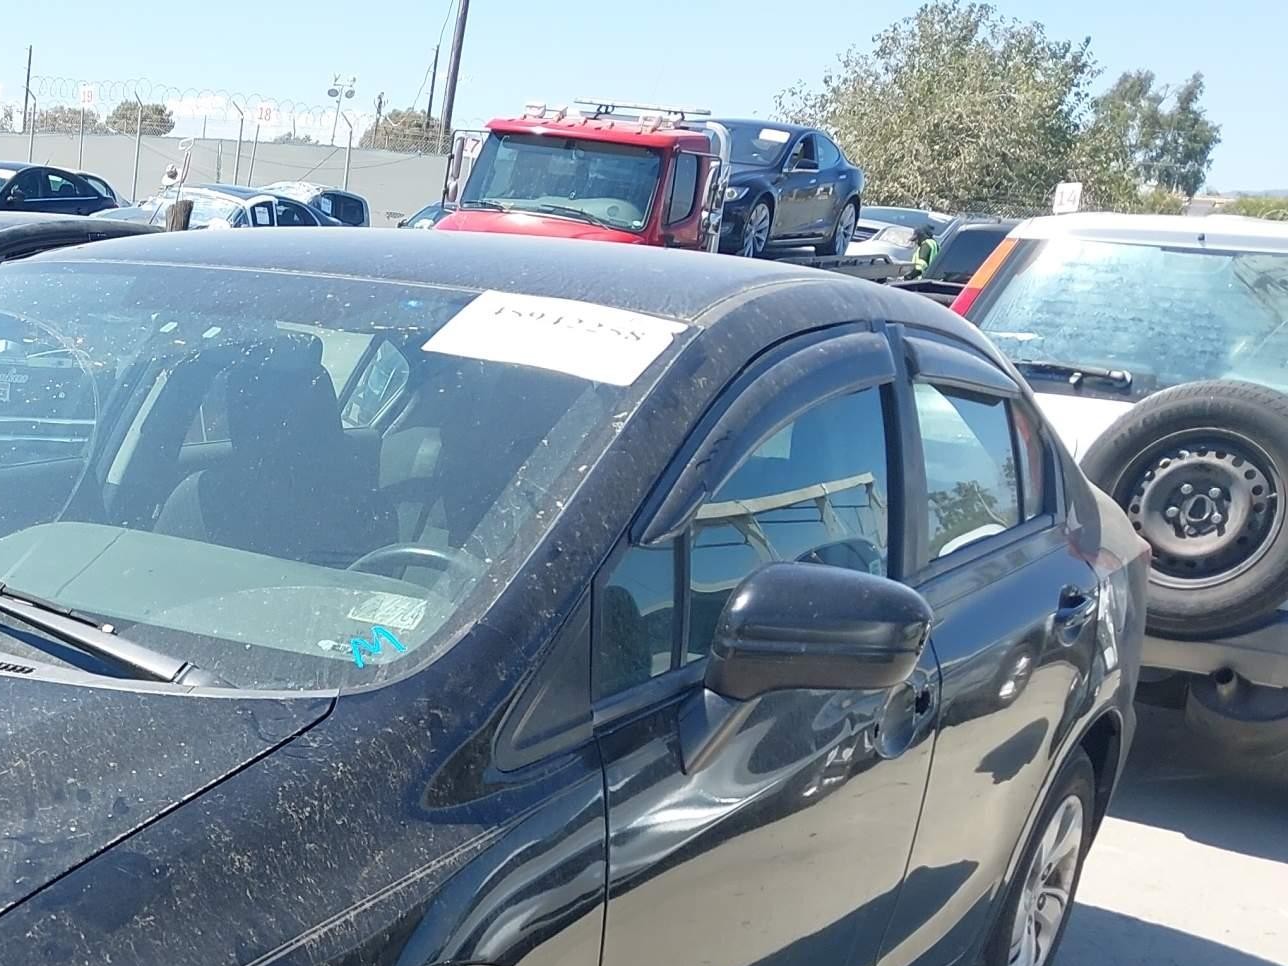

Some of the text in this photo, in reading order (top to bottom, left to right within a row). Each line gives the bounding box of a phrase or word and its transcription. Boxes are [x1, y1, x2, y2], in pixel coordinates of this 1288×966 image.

[81, 90, 93, 103] 19
[257, 107, 272, 122] 18
[1057, 190, 1077, 207] 14
